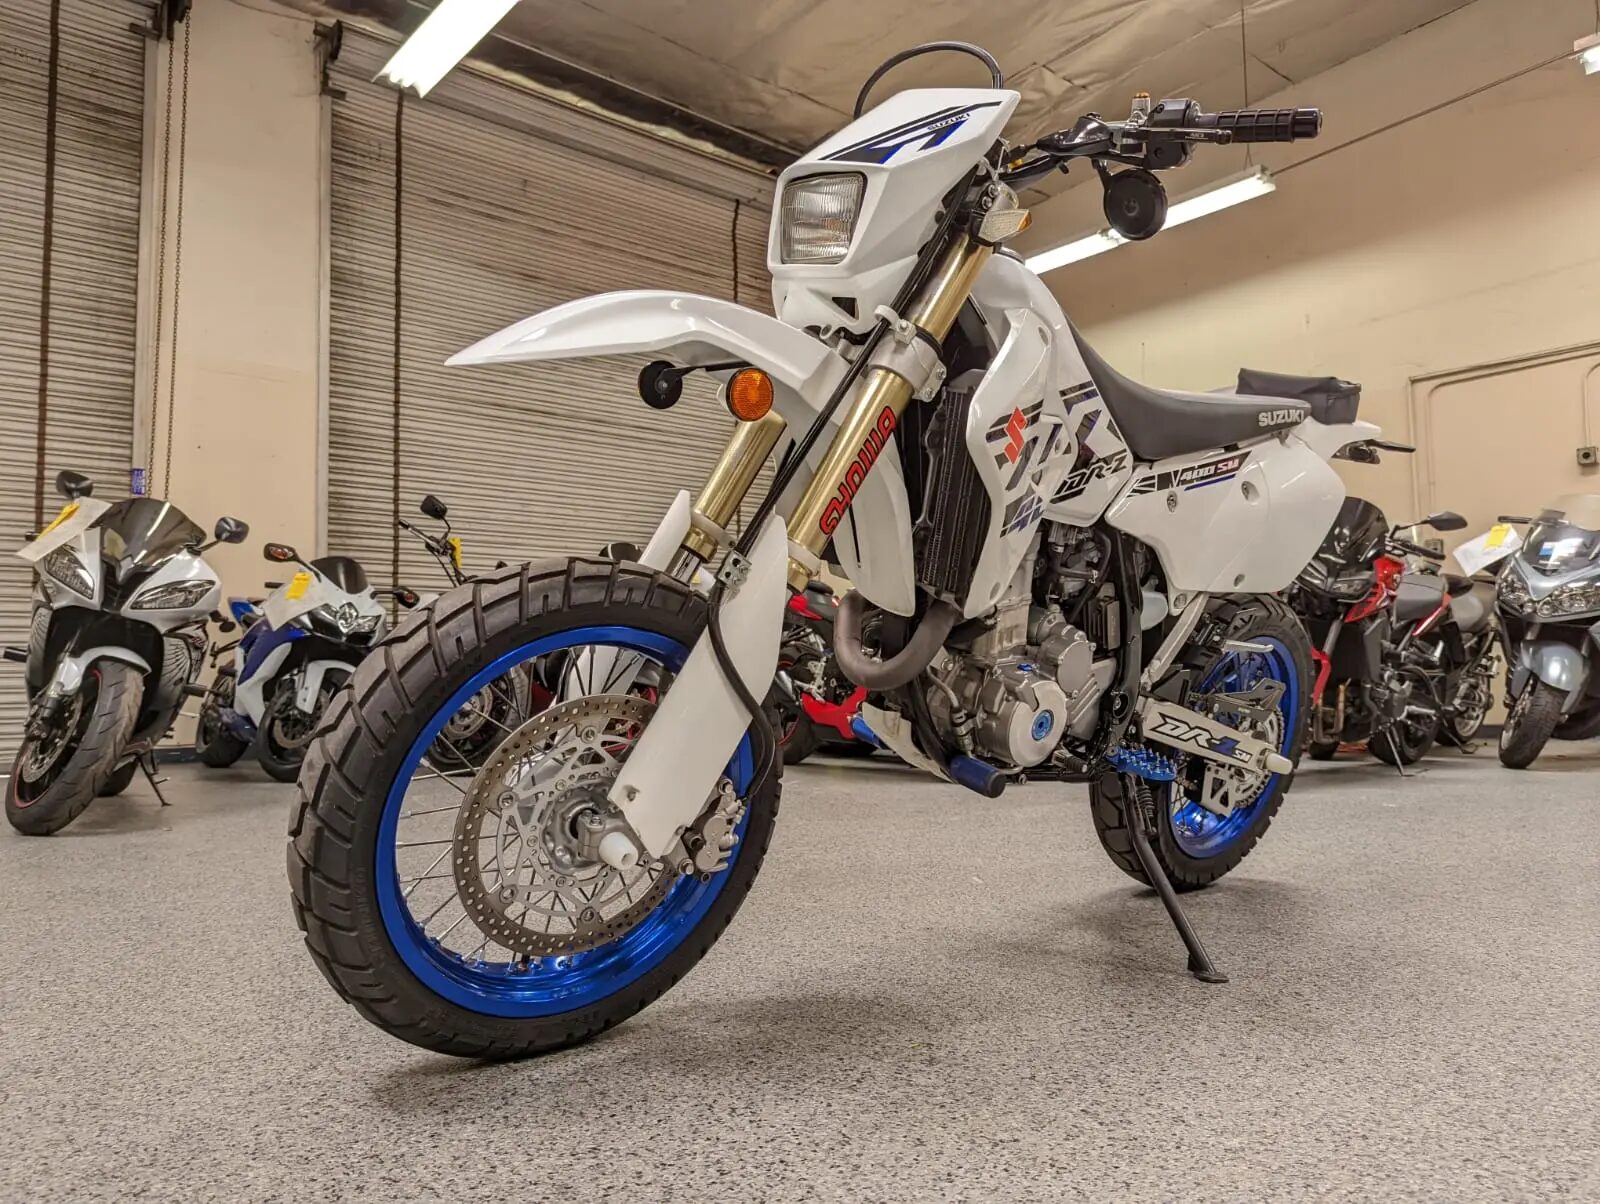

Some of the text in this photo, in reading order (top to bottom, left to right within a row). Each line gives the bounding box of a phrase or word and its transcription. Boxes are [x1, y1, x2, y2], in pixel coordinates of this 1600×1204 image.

[927, 112, 971, 131] SUZUKI
[1258, 408, 1305, 427] SUZUKI
[1180, 464, 1216, 481] 400
